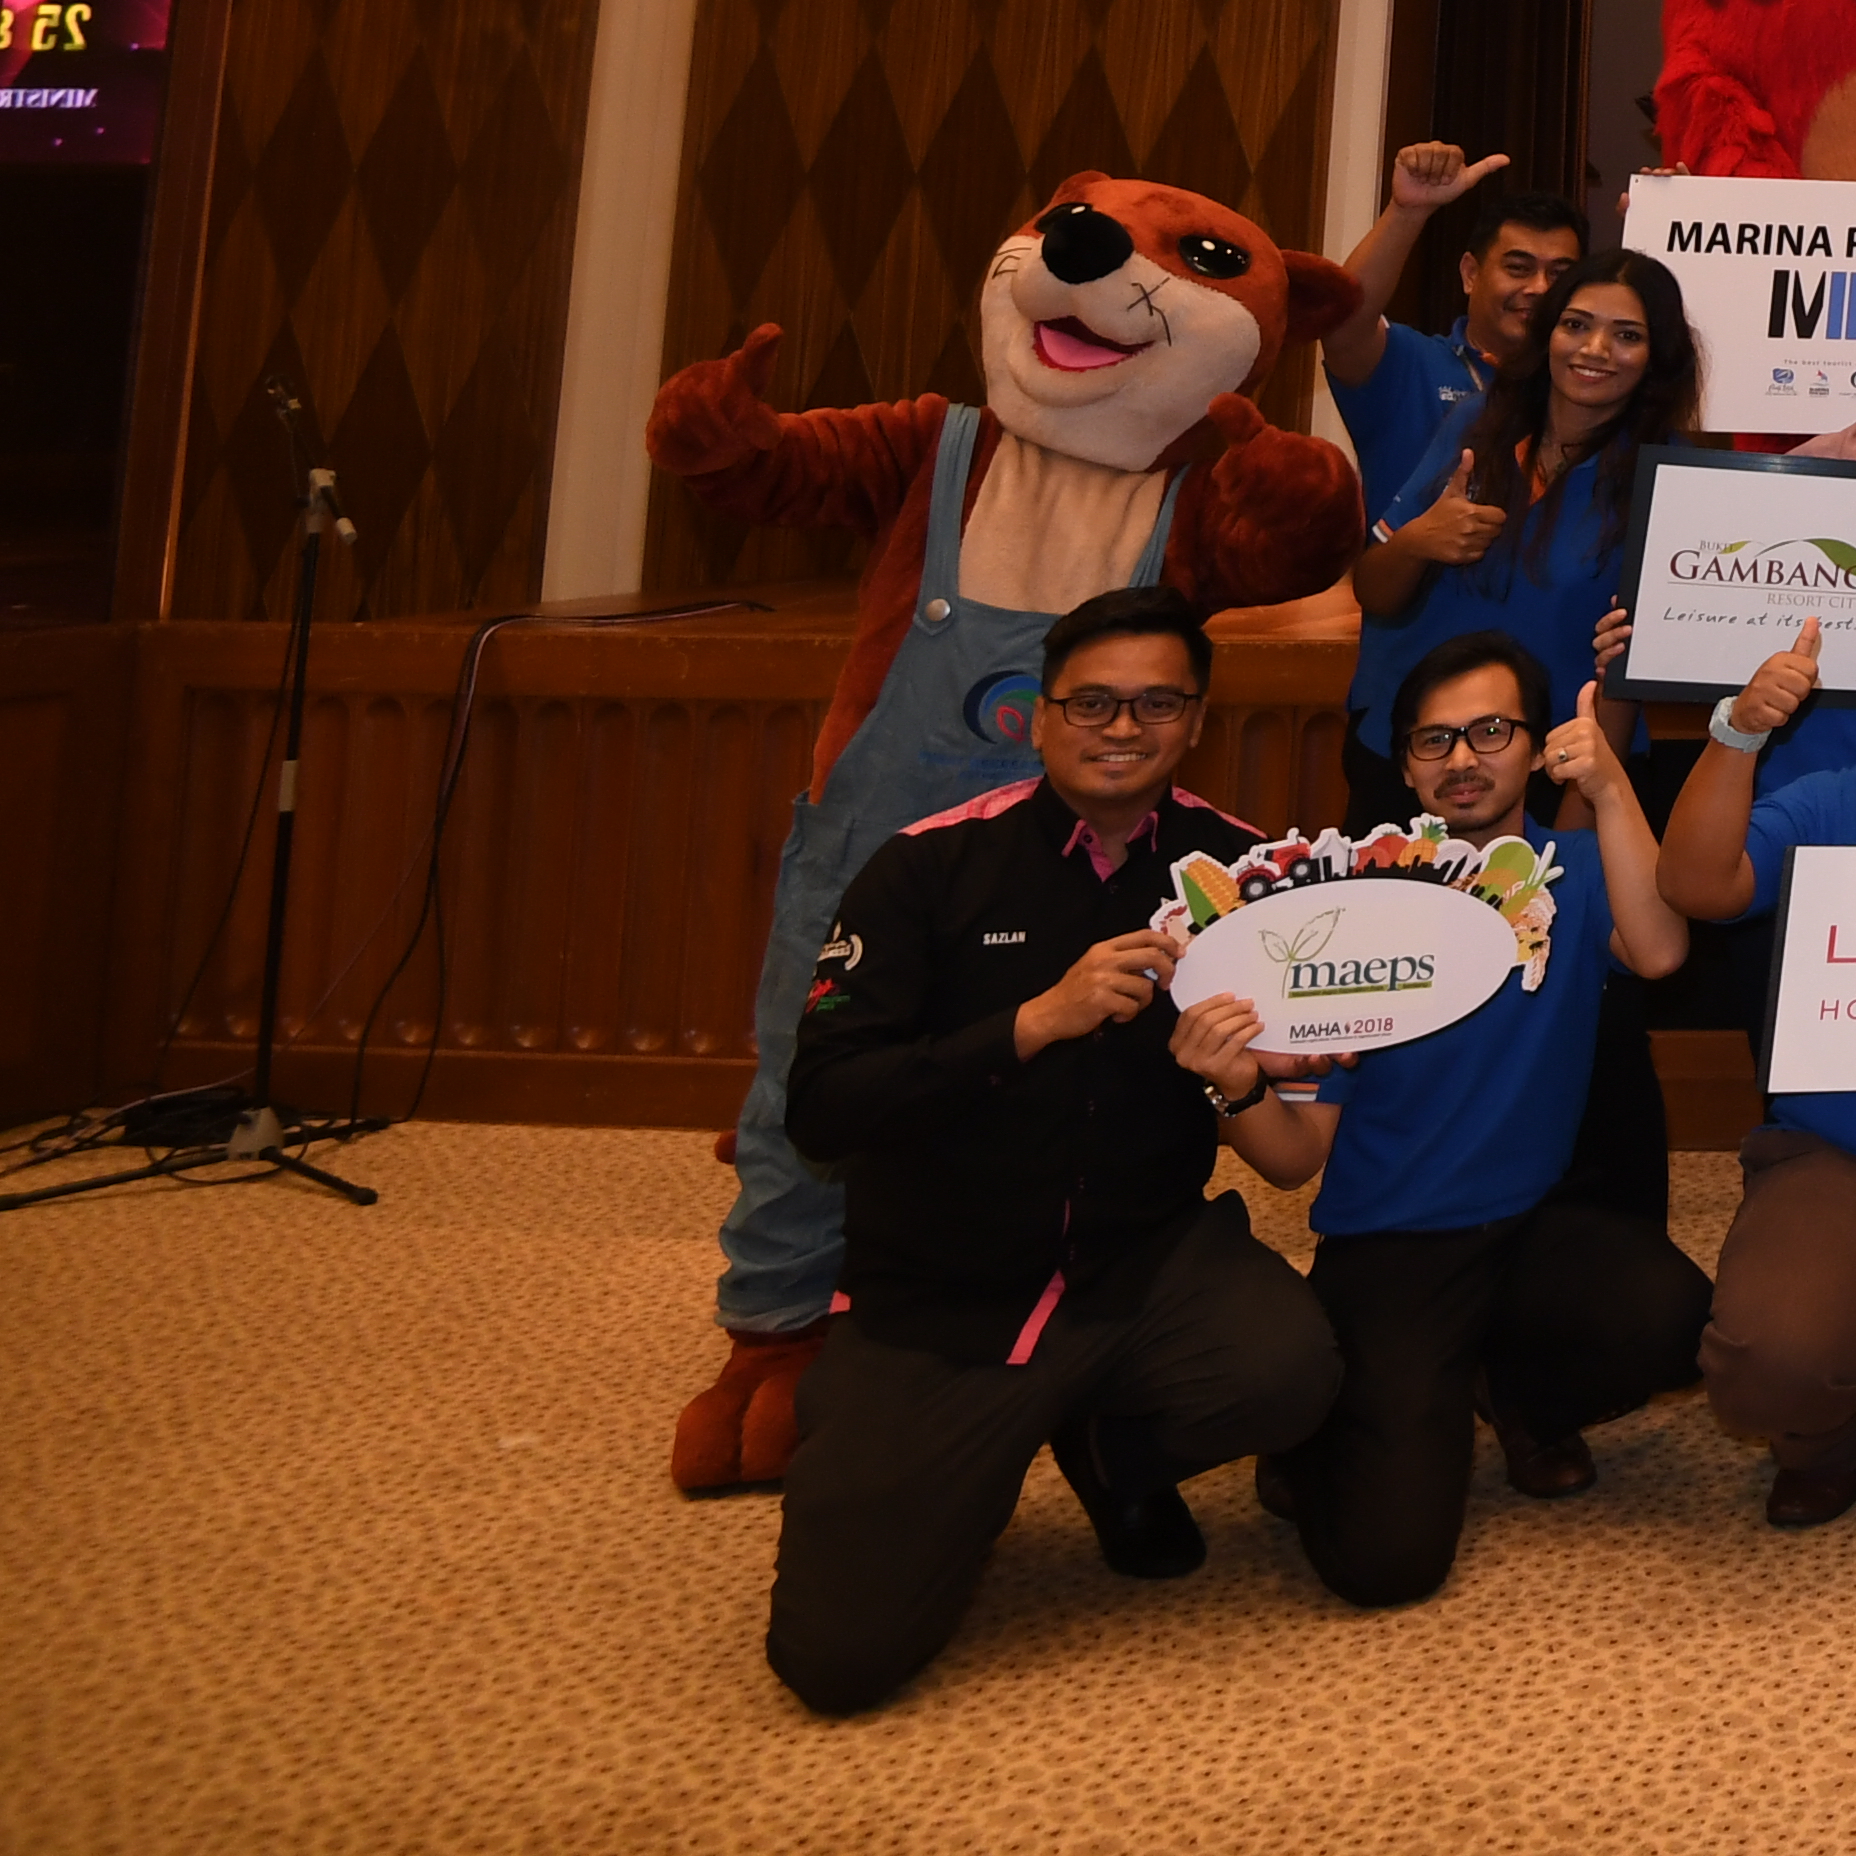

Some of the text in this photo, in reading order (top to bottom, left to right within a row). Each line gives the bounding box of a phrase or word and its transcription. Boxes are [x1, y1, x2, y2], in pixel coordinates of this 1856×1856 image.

[1666, 220, 1833, 258] MARINA
[1767, 592, 1826, 609] RESORT
[1663, 605, 1738, 626] Leisure
[1746, 612, 1768, 627] at
[983, 931, 1026, 945] SAZLAN
[1288, 952, 1436, 991] maeps
[1289, 1021, 1342, 1040] MAHA
[1353, 1016, 1394, 1034] 2018
